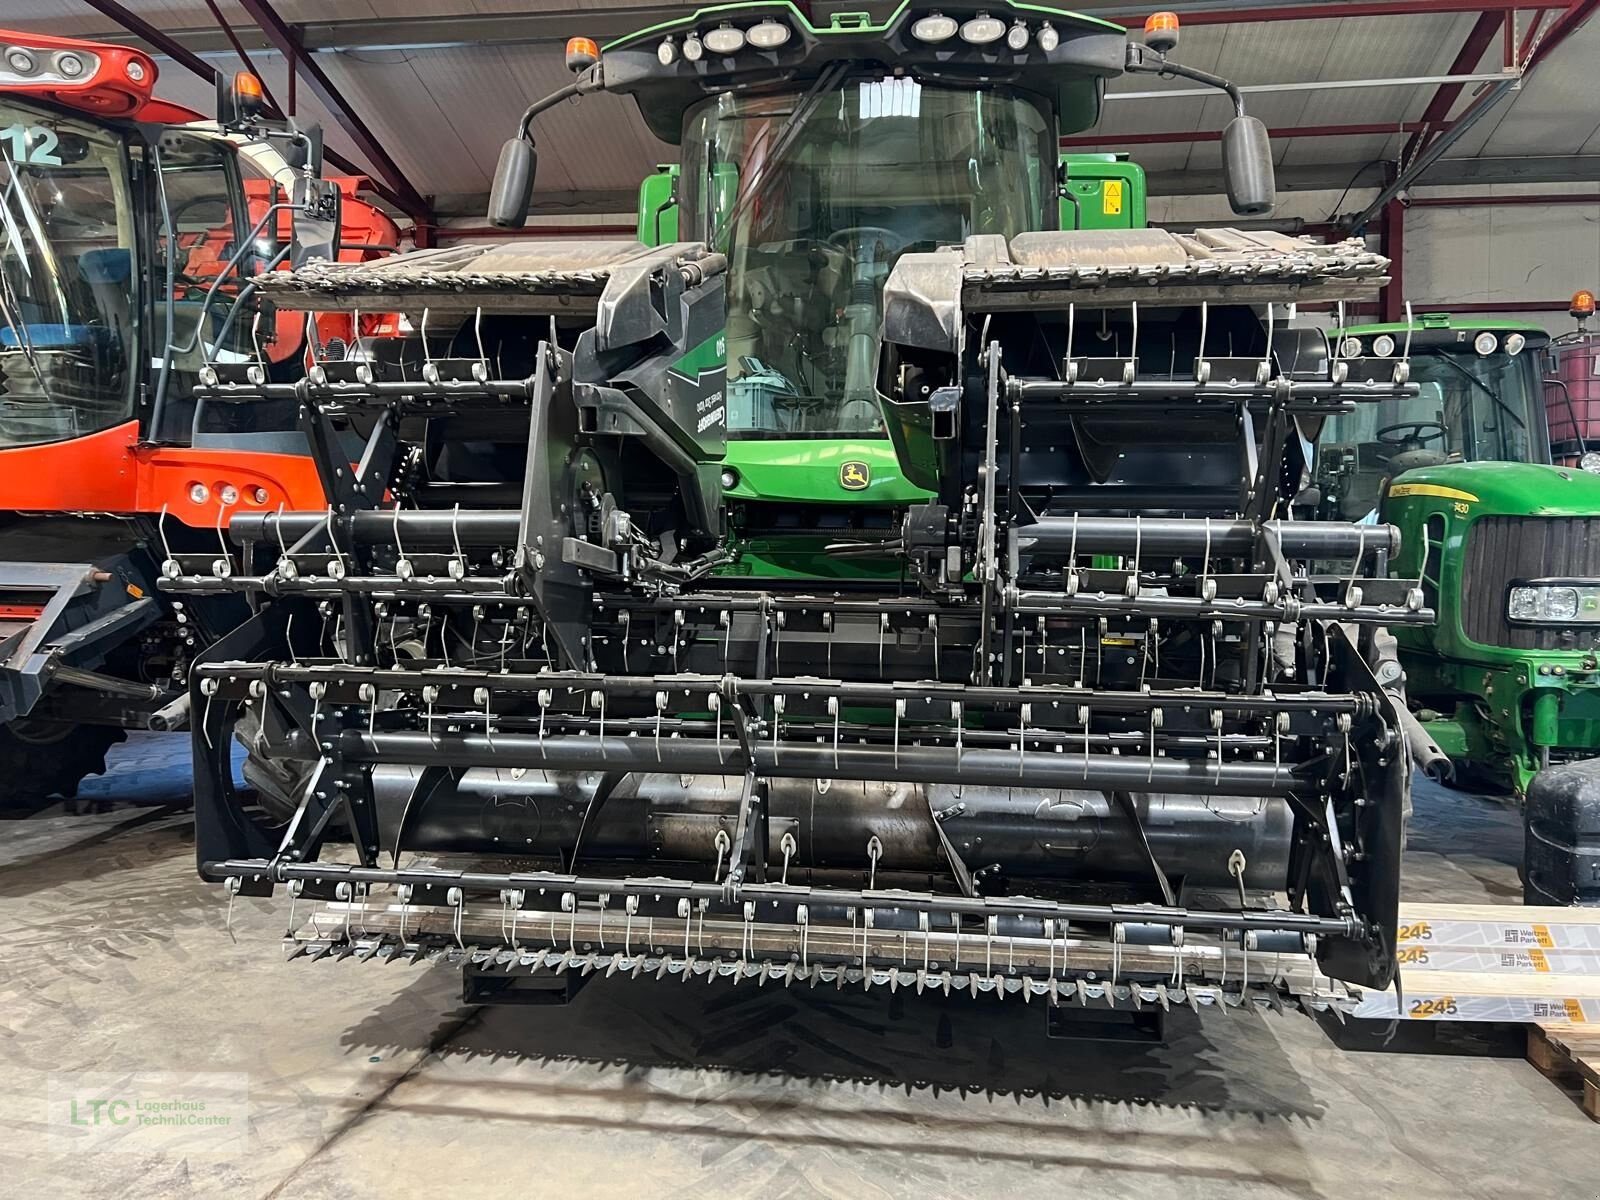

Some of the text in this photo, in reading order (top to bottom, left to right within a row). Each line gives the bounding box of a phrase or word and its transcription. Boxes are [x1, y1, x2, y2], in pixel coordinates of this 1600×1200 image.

[1399, 925, 1432, 940] 245
[1398, 949, 1429, 964] 245
[1411, 999, 1457, 1014] 2245
